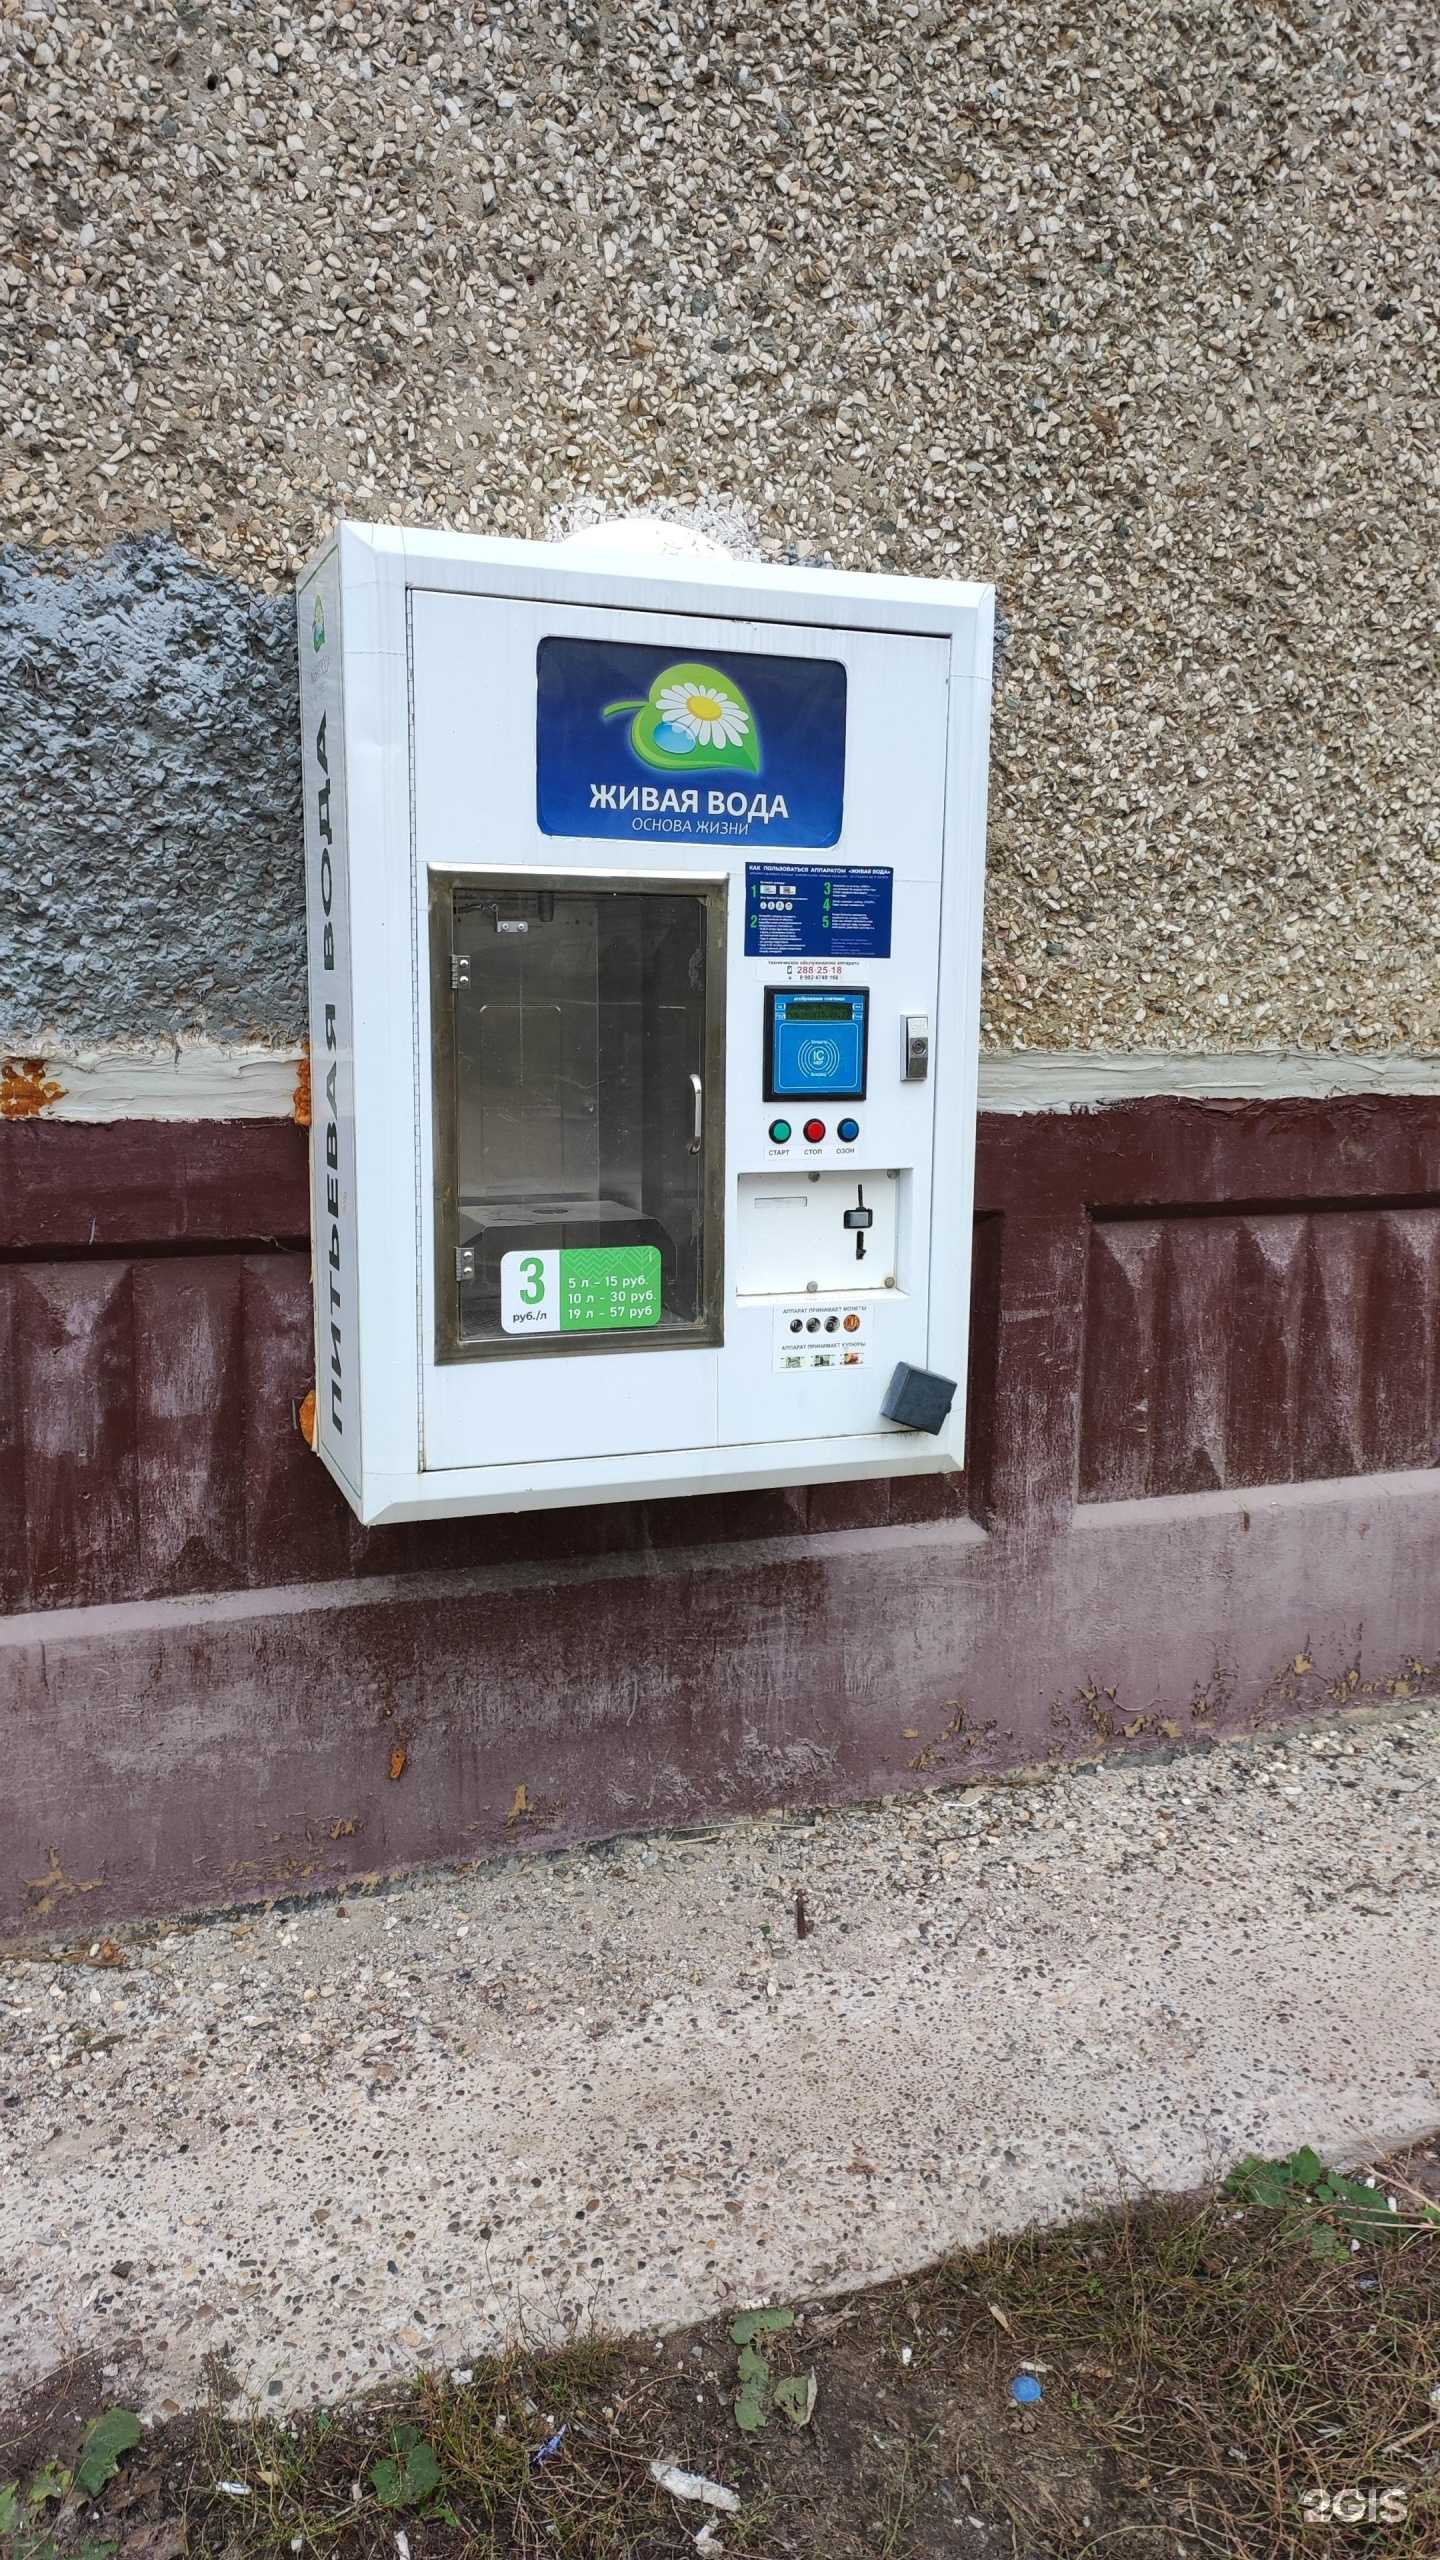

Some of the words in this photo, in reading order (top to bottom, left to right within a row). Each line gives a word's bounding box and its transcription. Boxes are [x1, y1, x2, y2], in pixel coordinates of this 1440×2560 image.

[589, 784, 698, 814] ЖИВАЯ
[708, 791, 789, 824] ВОДА
[632, 817, 692, 833] ОСНОВА
[696, 821, 748, 835] ЖИЗНИ
[316, 709, 333, 971] ВОДА
[751, 884, 757, 898] 1
[823, 881, 831, 895] 3
[822, 898, 831, 911] 4
[750, 914, 758, 928] 2
[822, 915, 829, 928] 5
[835, 1147, 855, 1155] ОЗОН
[325, 1004, 343, 1435] ПИТЬЕВАЯ
[519, 1257, 545, 1305] 3
[568, 1277, 576, 1289] 5
[581, 1280, 589, 1288] л
[605, 1276, 618, 1287] 15
[622, 1275, 649, 1288] руб.
[568, 1293, 582, 1304] 10
[586, 1296, 594, 1304] л
[610, 1291, 626, 1303] 30
[630, 1290, 657, 1303] руб.
[512, 1310, 547, 1323] руб./л
[568, 1308, 581, 1319] 19
[610, 1306, 625, 1318] 57
[629, 1305, 653, 1319] руб
